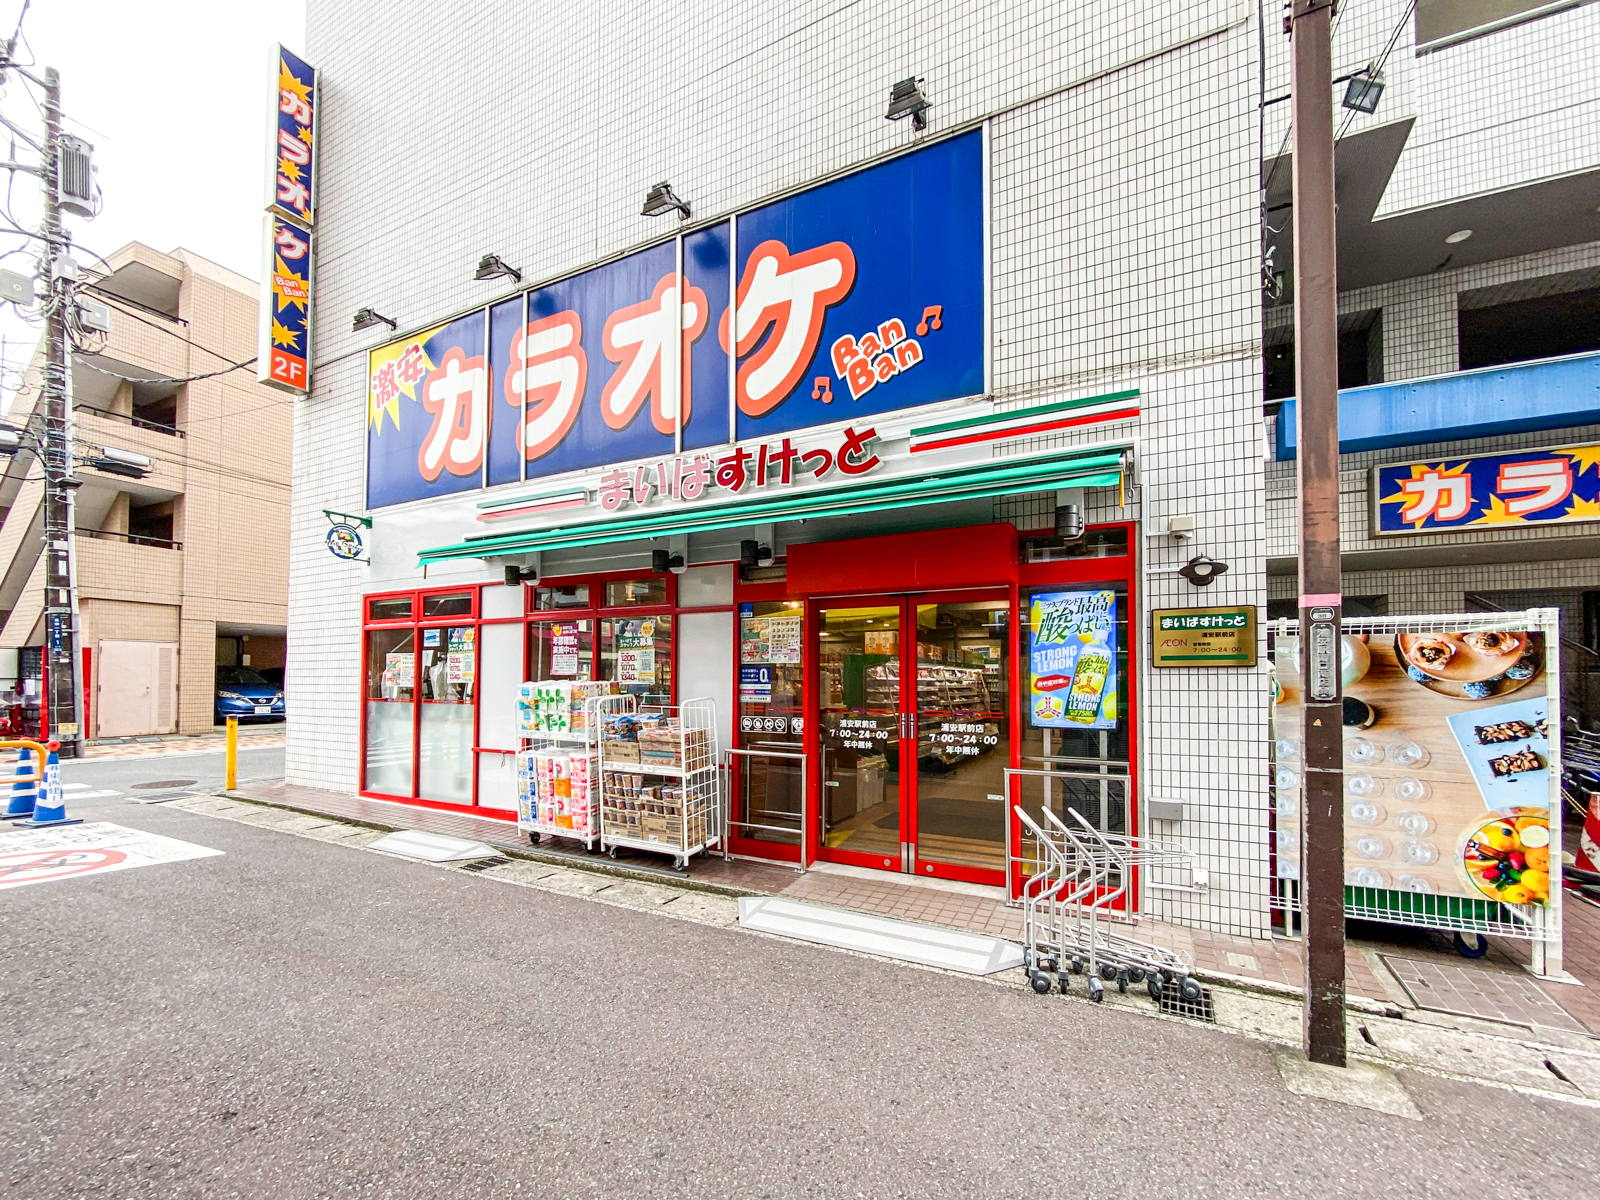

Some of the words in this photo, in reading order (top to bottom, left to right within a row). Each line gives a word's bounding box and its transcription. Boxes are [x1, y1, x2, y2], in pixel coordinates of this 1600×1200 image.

[277, 88, 312, 261] カラオケ
[274, 275, 300, 290] Ban
[282, 285, 307, 299] Ban
[831, 318, 907, 380] Ban
[274, 356, 303, 380] 2F
[418, 239, 856, 481] カラオケ
[372, 343, 424, 411] 激安
[846, 339, 924, 401] Ban
[598, 426, 883, 511] まいばすけっと
[1402, 457, 1600, 524] カラ
[1161, 615, 1246, 629] まいばすけっと
[1033, 645, 1078, 663] STRONG
[1037, 656, 1074, 673] LEMON
[1068, 701, 1098, 711] LEMON
[1069, 693, 1102, 703] STRONG
[839, 719, 877, 729] 浦安駅前店
[940, 723, 985, 733] 浦安駅前店
[843, 740, 873, 749] 年中無休
[945, 745, 980, 756] 年中無休
